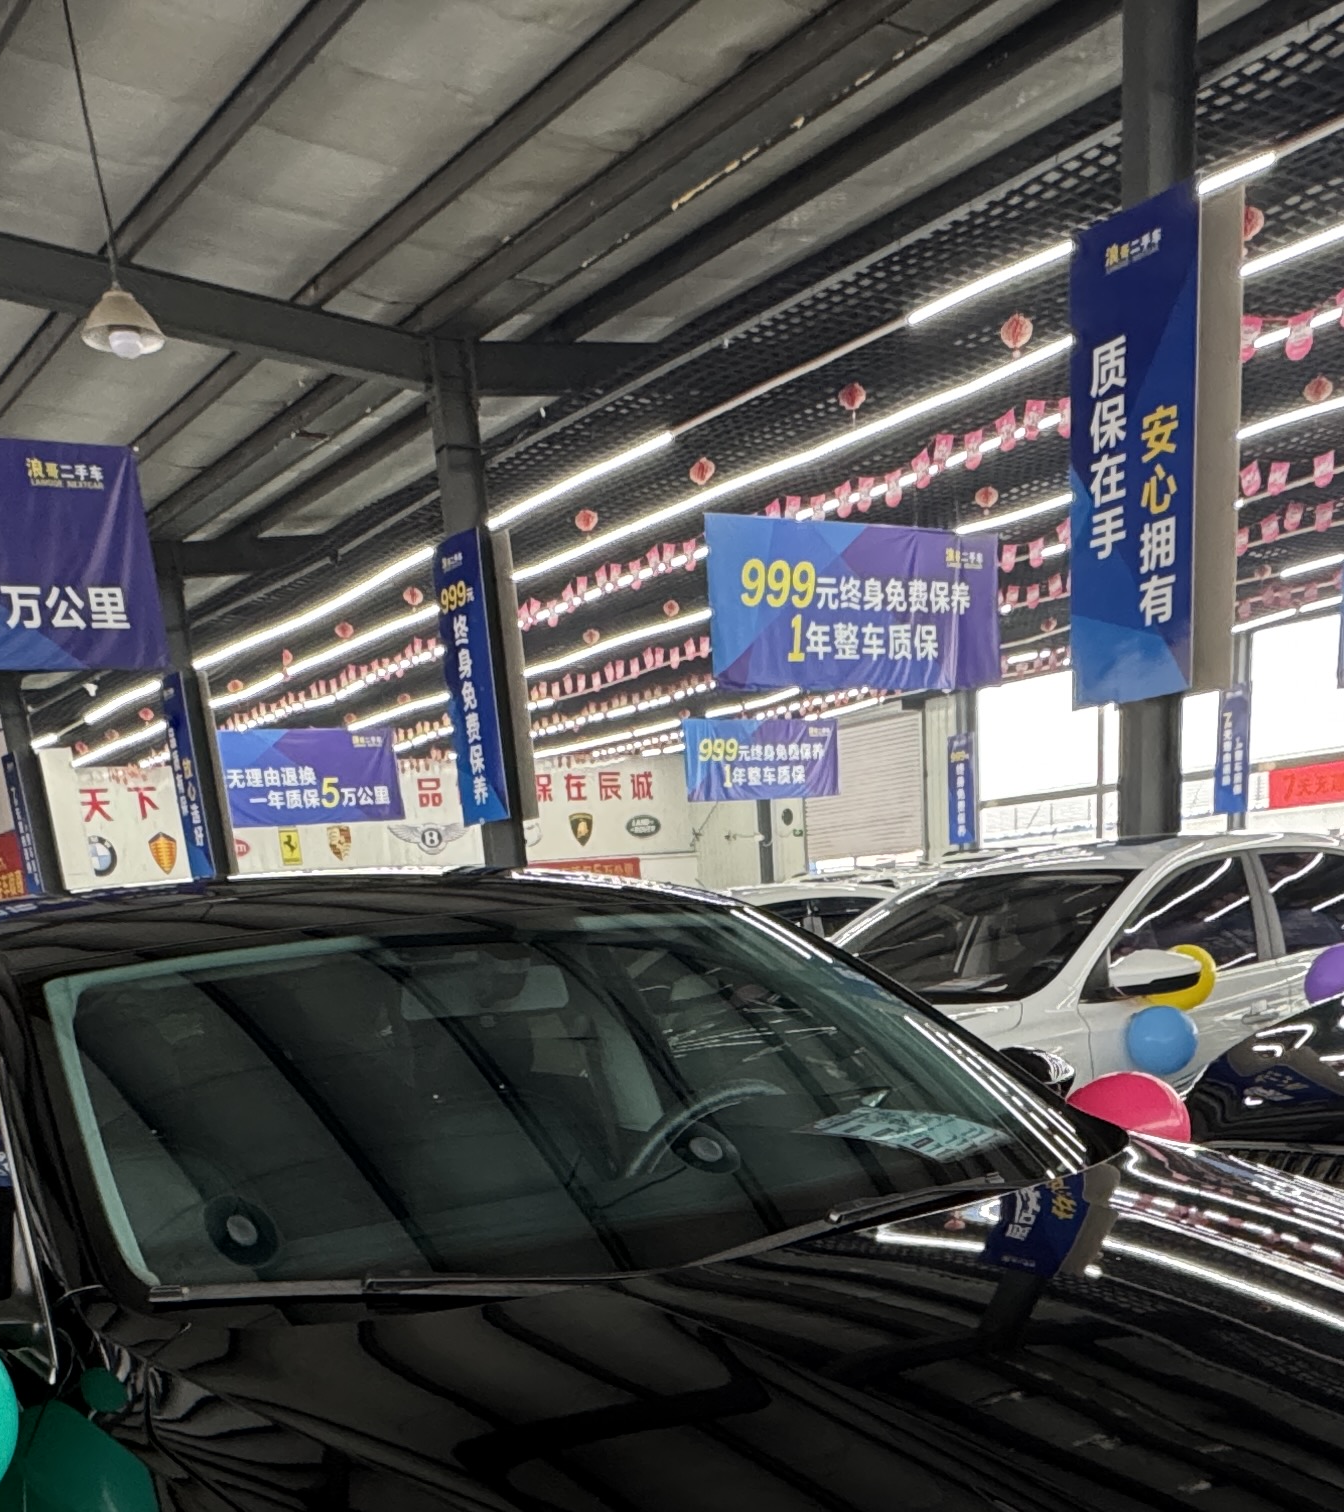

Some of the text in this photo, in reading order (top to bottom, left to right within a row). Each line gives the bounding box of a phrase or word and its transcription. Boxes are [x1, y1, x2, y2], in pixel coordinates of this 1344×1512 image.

[1090, 335, 1127, 560] 质保在手
[25, 457, 104, 481] 浪哥二手车
[1139, 404, 1179, 627] 安心拥有
[741, 558, 971, 615] 999元终身免费保养
[787, 613, 939, 662] 1年整车质保
[453, 614, 488, 805] 终身免费保养
[698, 738, 825, 762] 999元终身免费保养
[249, 777, 391, 809] 一年质保5万公里
[417, 778, 443, 807] 品
[723, 764, 806, 788] 1年整车质保
